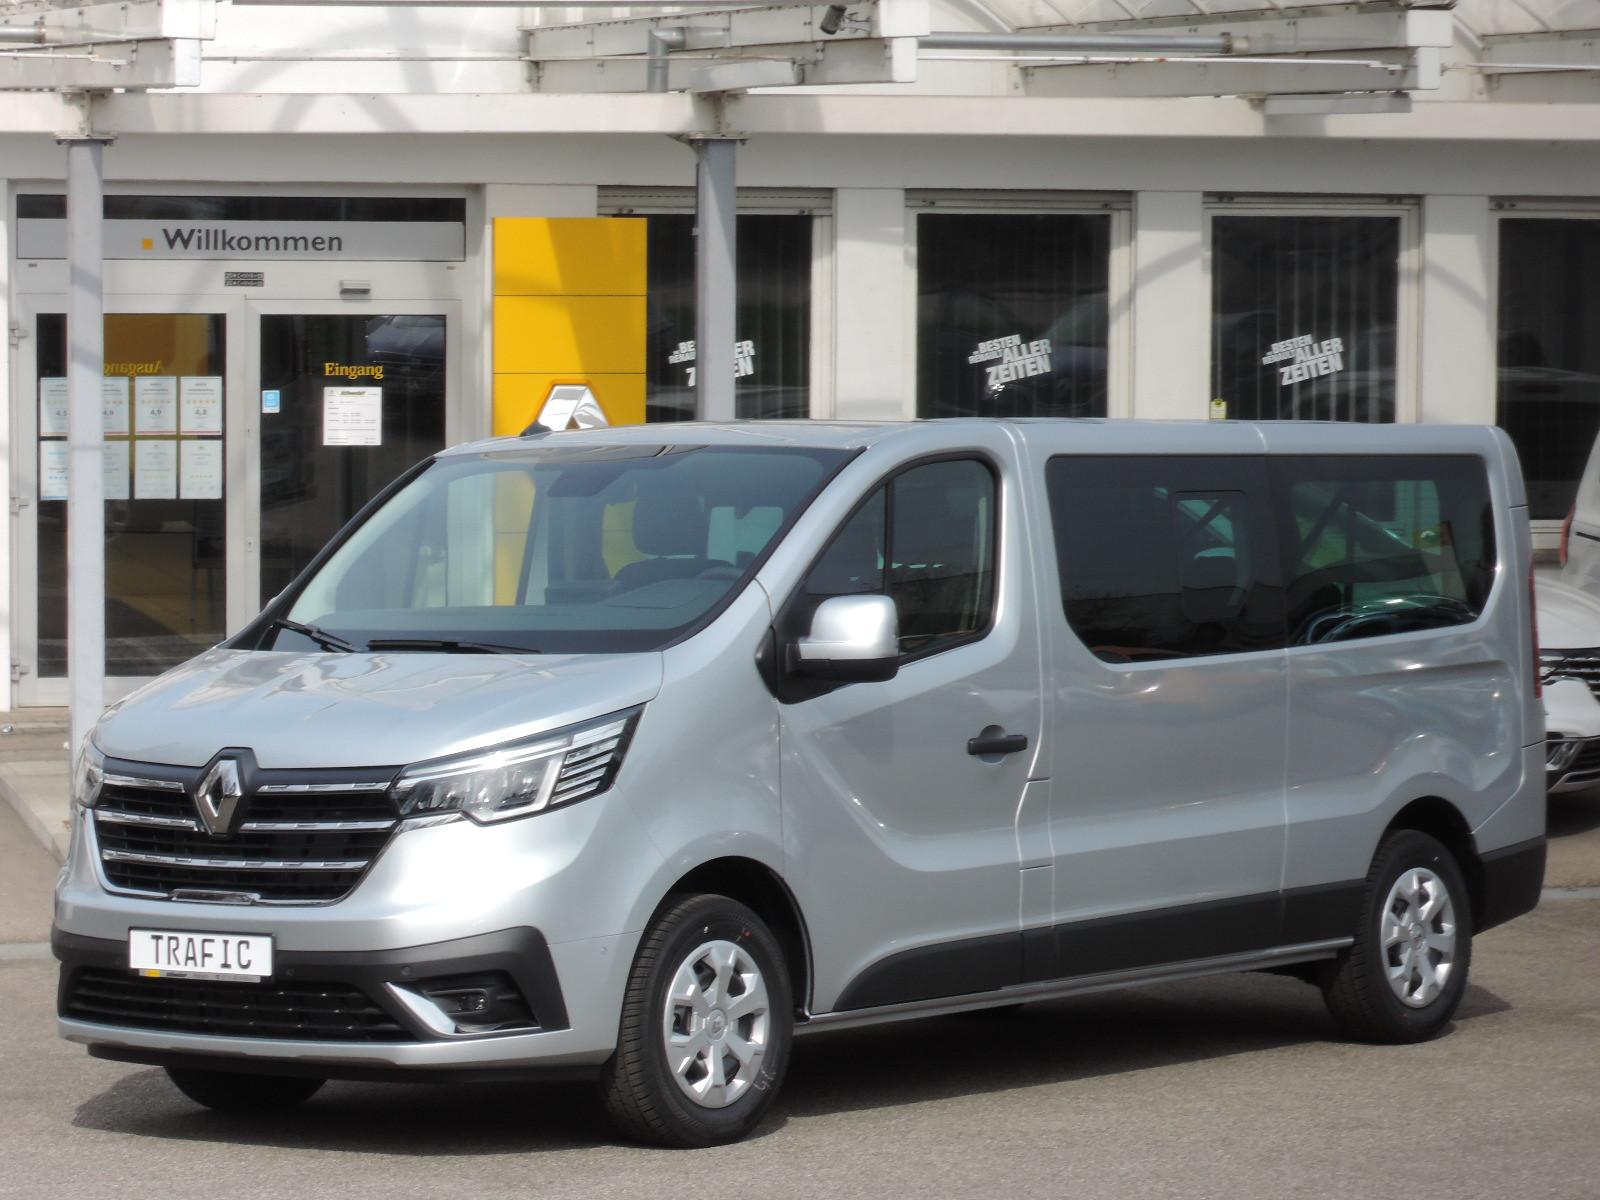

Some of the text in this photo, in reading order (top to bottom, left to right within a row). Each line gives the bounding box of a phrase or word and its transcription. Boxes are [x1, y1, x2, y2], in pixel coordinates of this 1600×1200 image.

[162, 228, 343, 251] Willkommen
[978, 334, 1021, 354] BESTEN
[1003, 339, 1052, 364] ALLER
[1271, 334, 1313, 354] BESTEN
[1295, 337, 1344, 364] ALLER
[324, 362, 384, 379] Eingang
[985, 354, 1052, 386] ZEITEN
[1279, 352, 1343, 386] ZEITEN
[151, 934, 252, 969] TRAFIC
